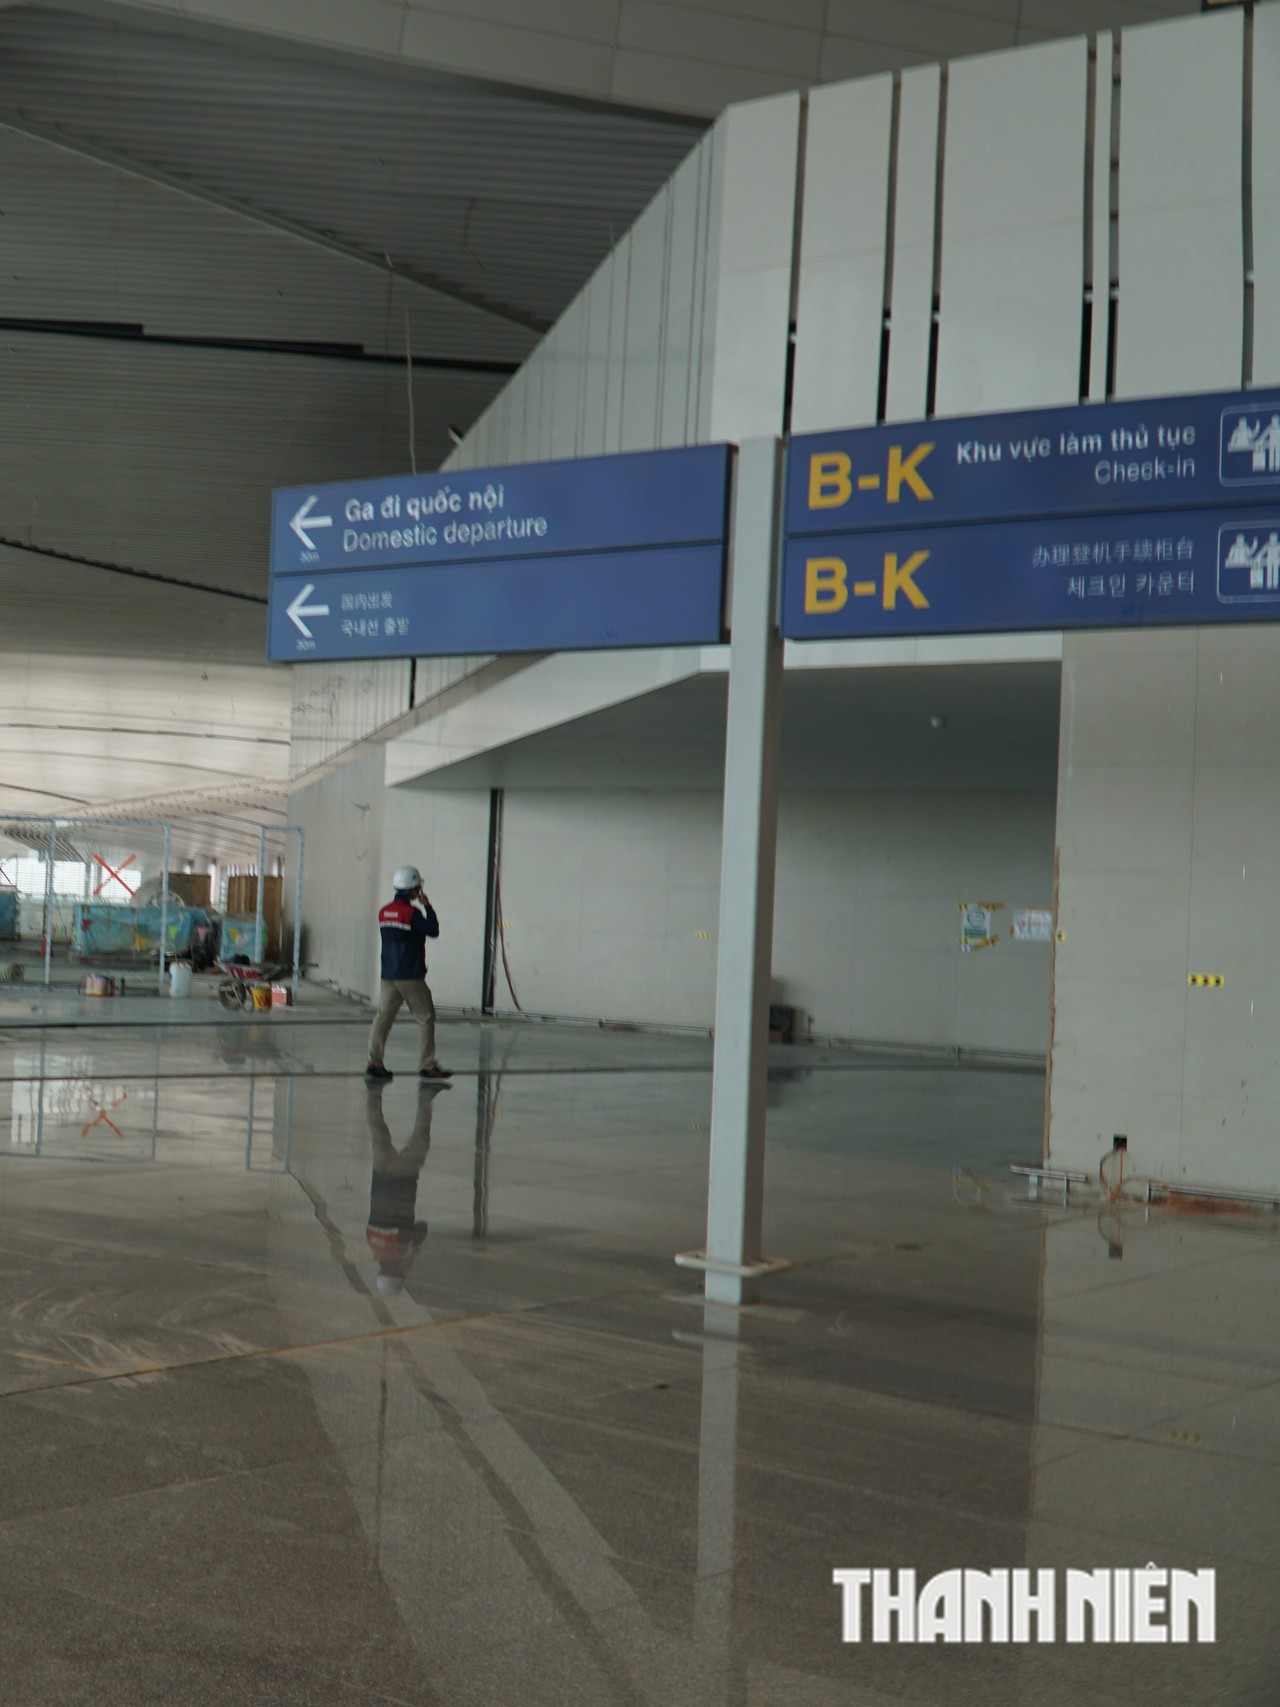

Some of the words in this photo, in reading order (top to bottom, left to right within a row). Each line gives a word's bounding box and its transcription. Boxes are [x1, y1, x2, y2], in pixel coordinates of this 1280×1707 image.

[957, 440, 1002, 465] Khu
[1009, 436, 1051, 463] vực
[1060, 432, 1103, 456] làm
[1110, 423, 1149, 451] thủ
[1157, 424, 1196, 452] tục
[808, 441, 936, 510] B-K
[1094, 454, 1196, 485] Check-in
[344, 498, 375, 522] Ga
[380, 494, 401, 519] đi
[406, 485, 462, 521] quốc
[468, 484, 504, 514] nội
[343, 521, 438, 552] Domestic
[443, 515, 548, 548] departure
[804, 549, 932, 615] B-K
